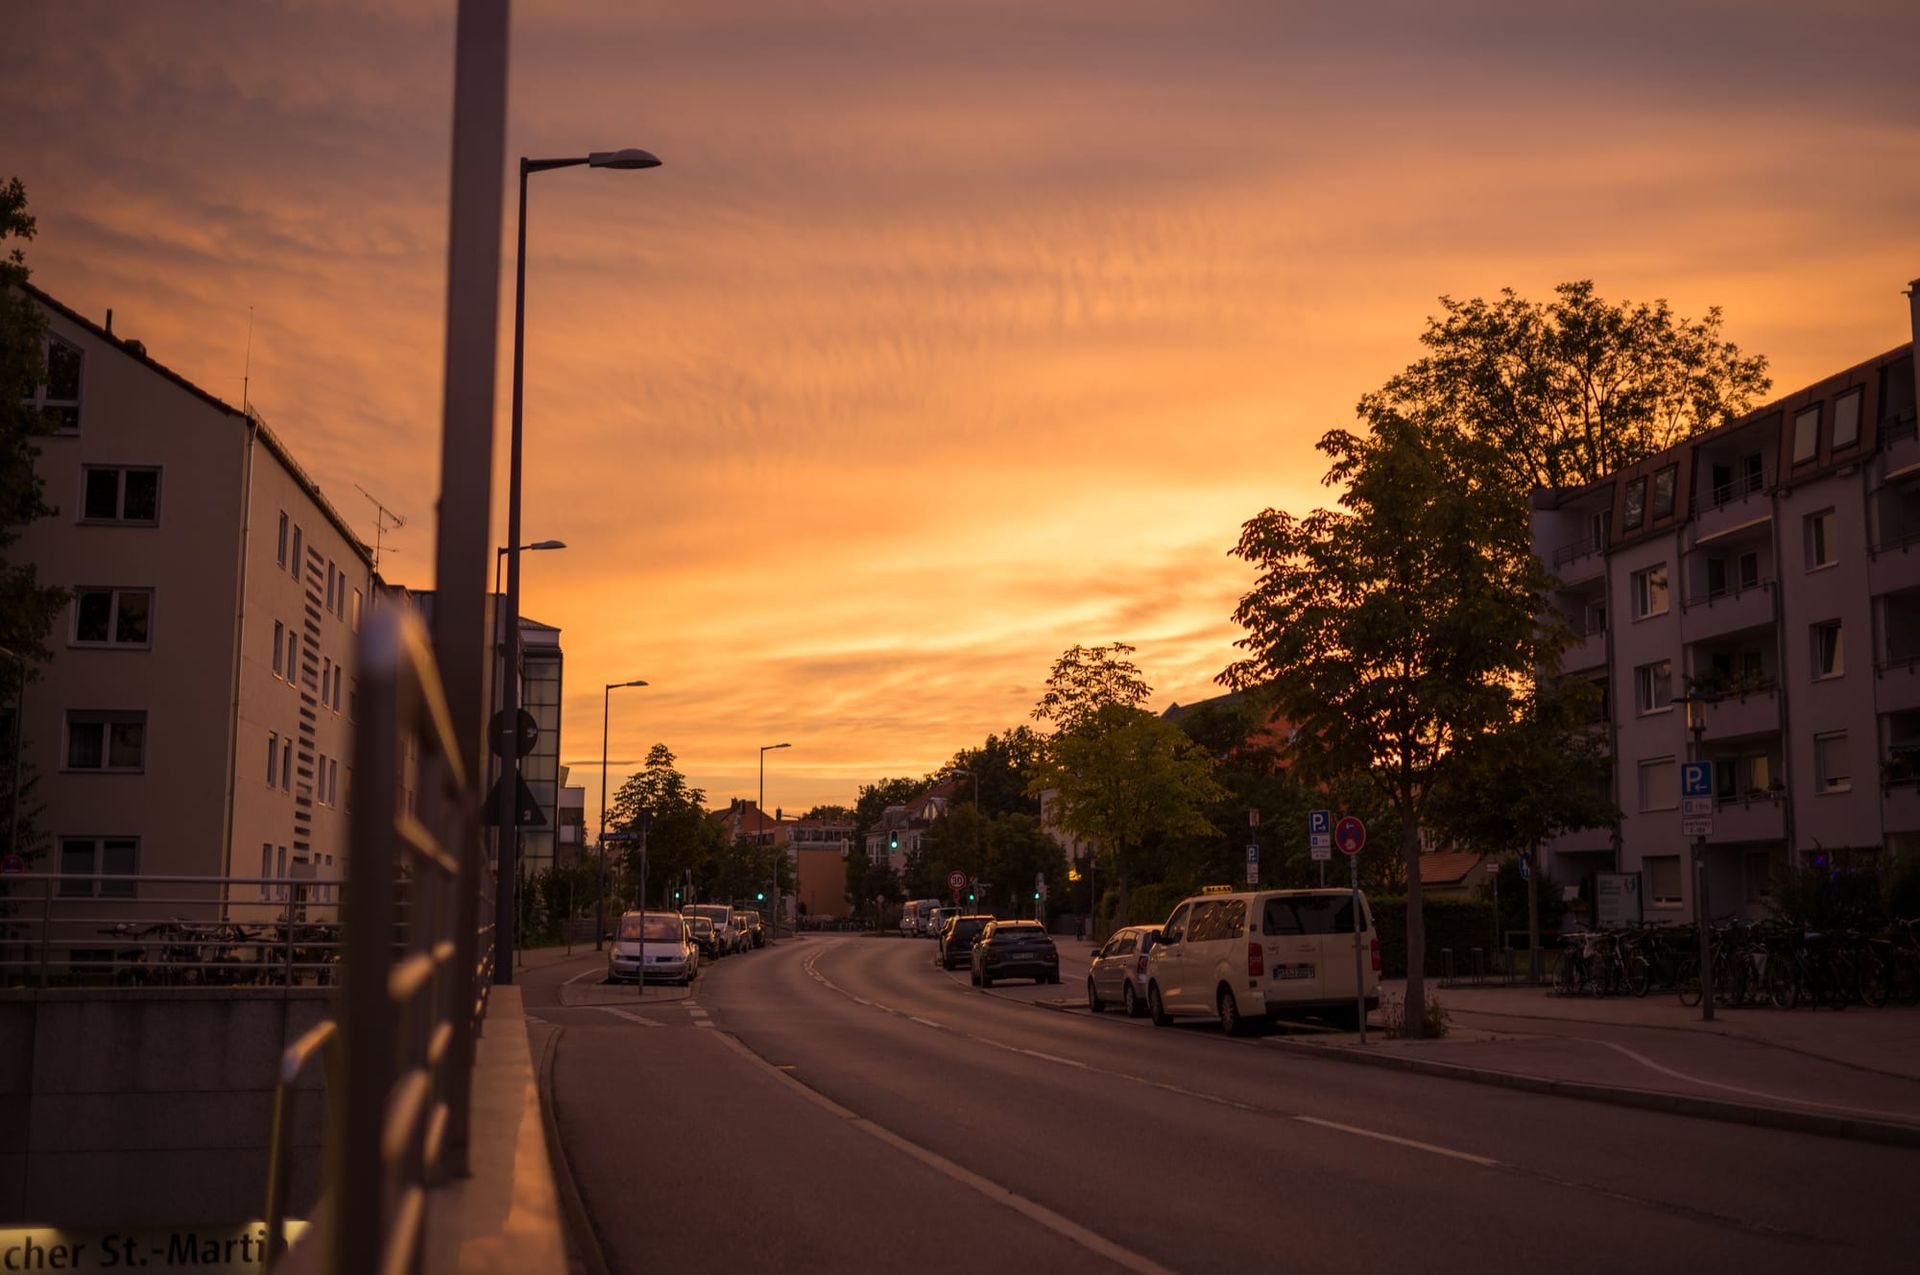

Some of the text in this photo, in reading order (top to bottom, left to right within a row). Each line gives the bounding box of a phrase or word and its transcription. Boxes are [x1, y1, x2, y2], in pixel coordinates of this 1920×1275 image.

[1686, 766, 1703, 792] P
[1312, 813, 1324, 832] P
[951, 876, 963, 886] 30
[4, 1230, 288, 1271] cher St.-Marti
